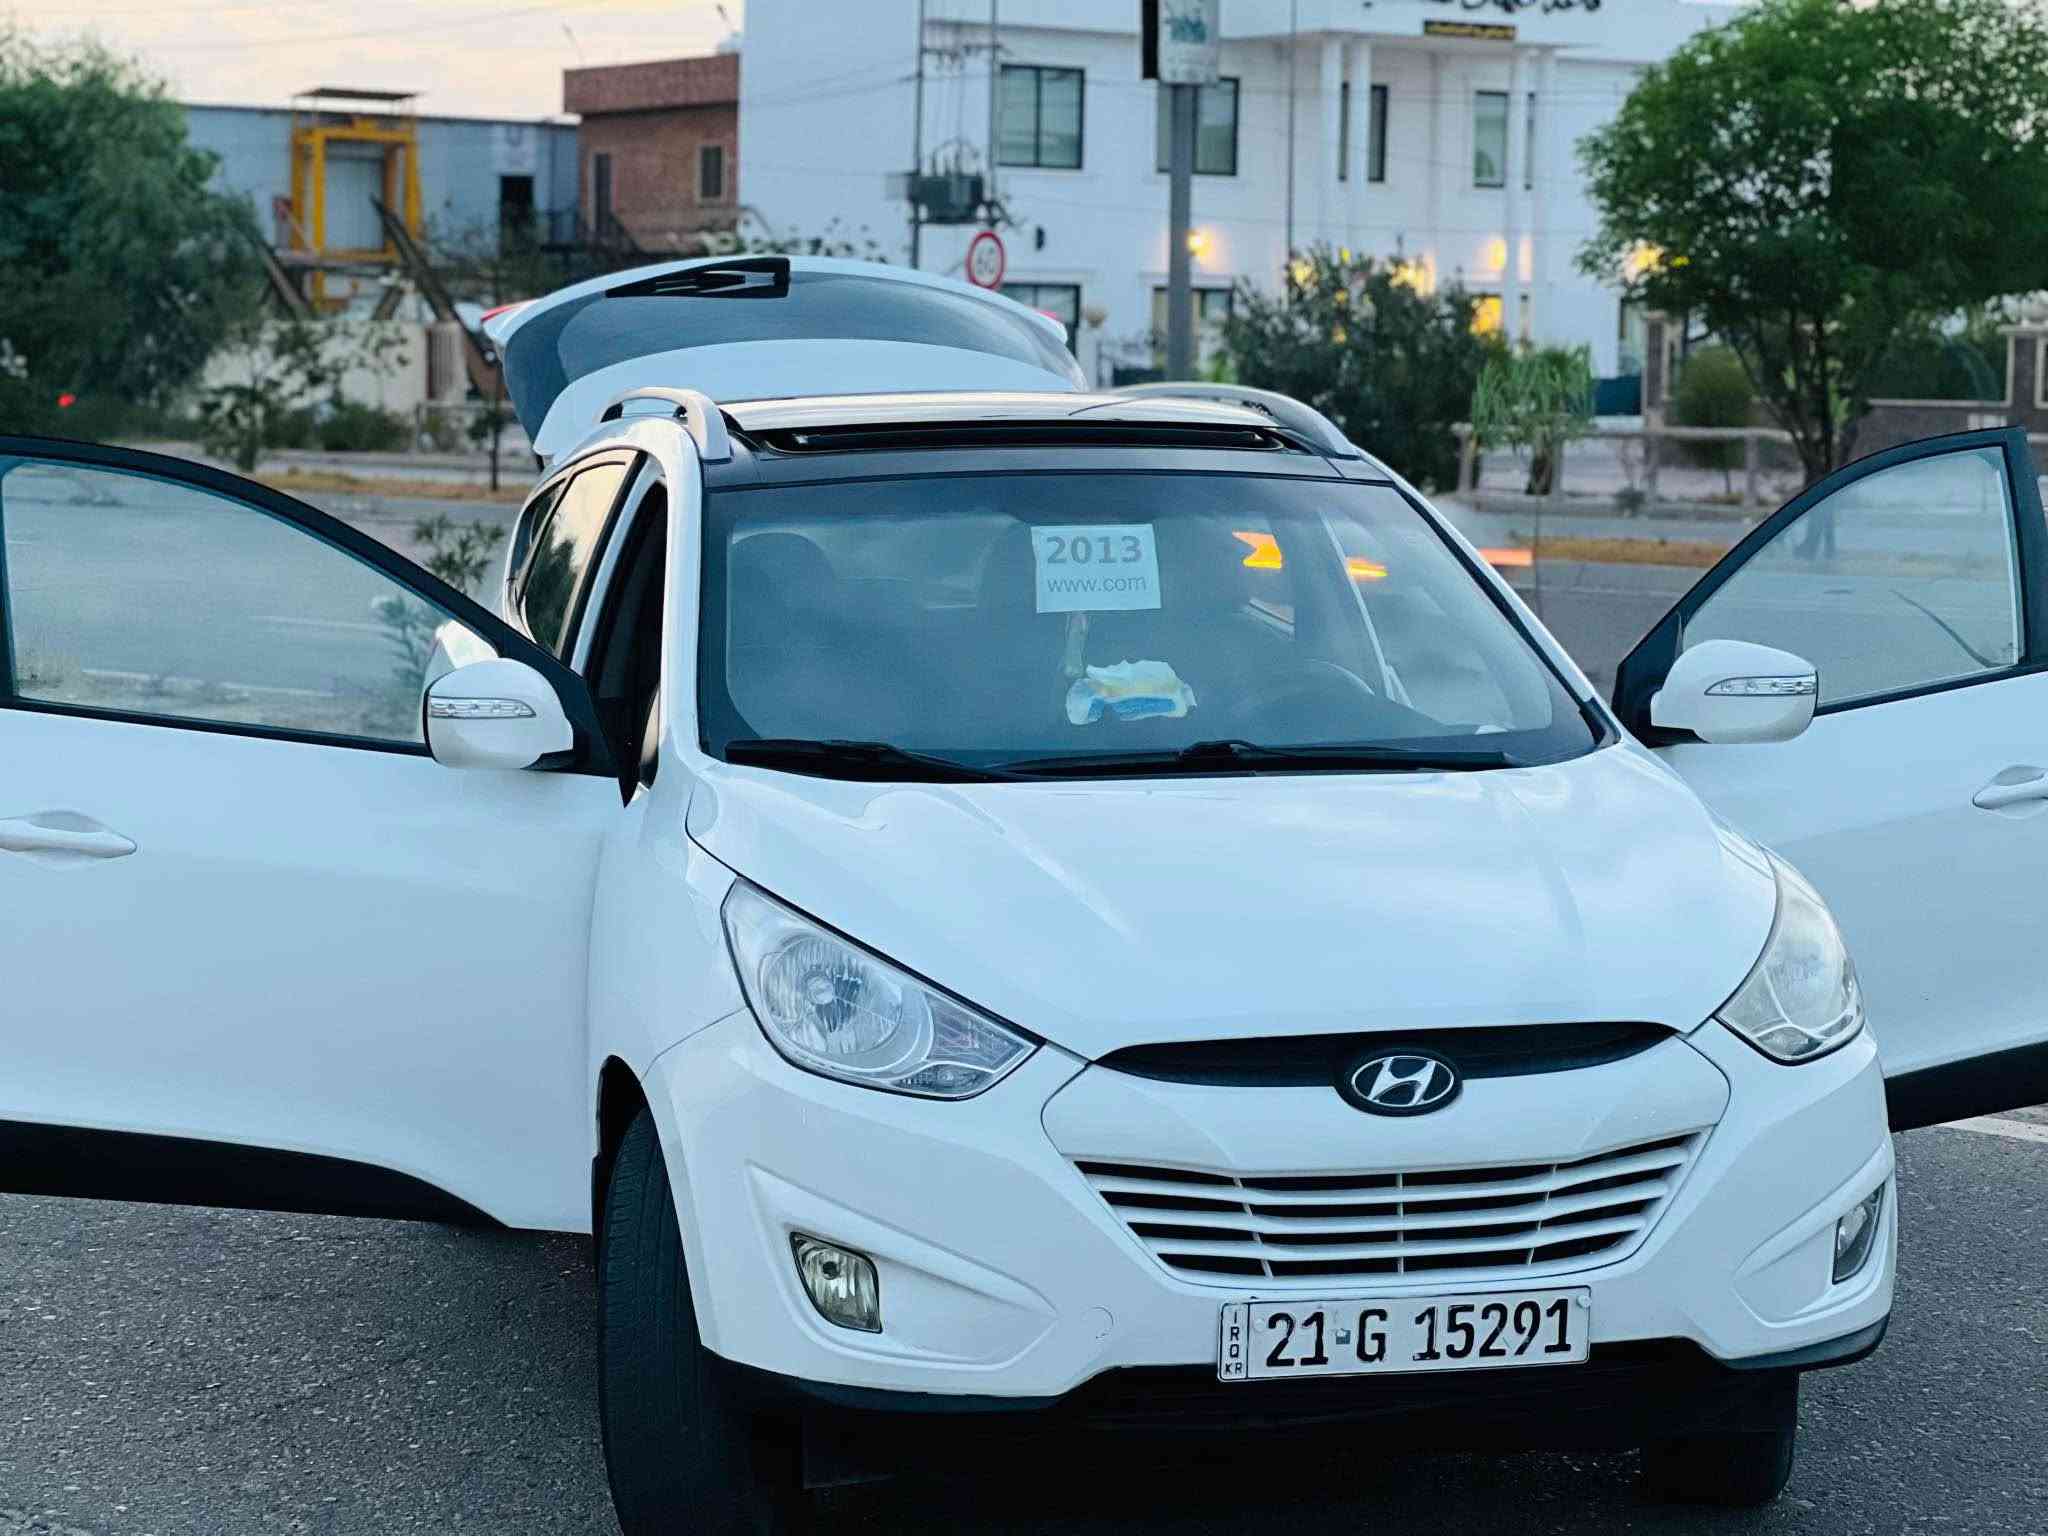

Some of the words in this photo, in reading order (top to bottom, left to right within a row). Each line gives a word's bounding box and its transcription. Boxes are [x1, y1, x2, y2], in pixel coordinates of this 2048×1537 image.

[1046, 535, 1143, 564] 2013
[1048, 577, 1147, 593] www.com
[1266, 1311, 1329, 1367] 21
[1356, 1308, 1388, 1363] G
[1412, 1298, 1571, 1361] 15291
[1225, 1362, 1243, 1376] KR
